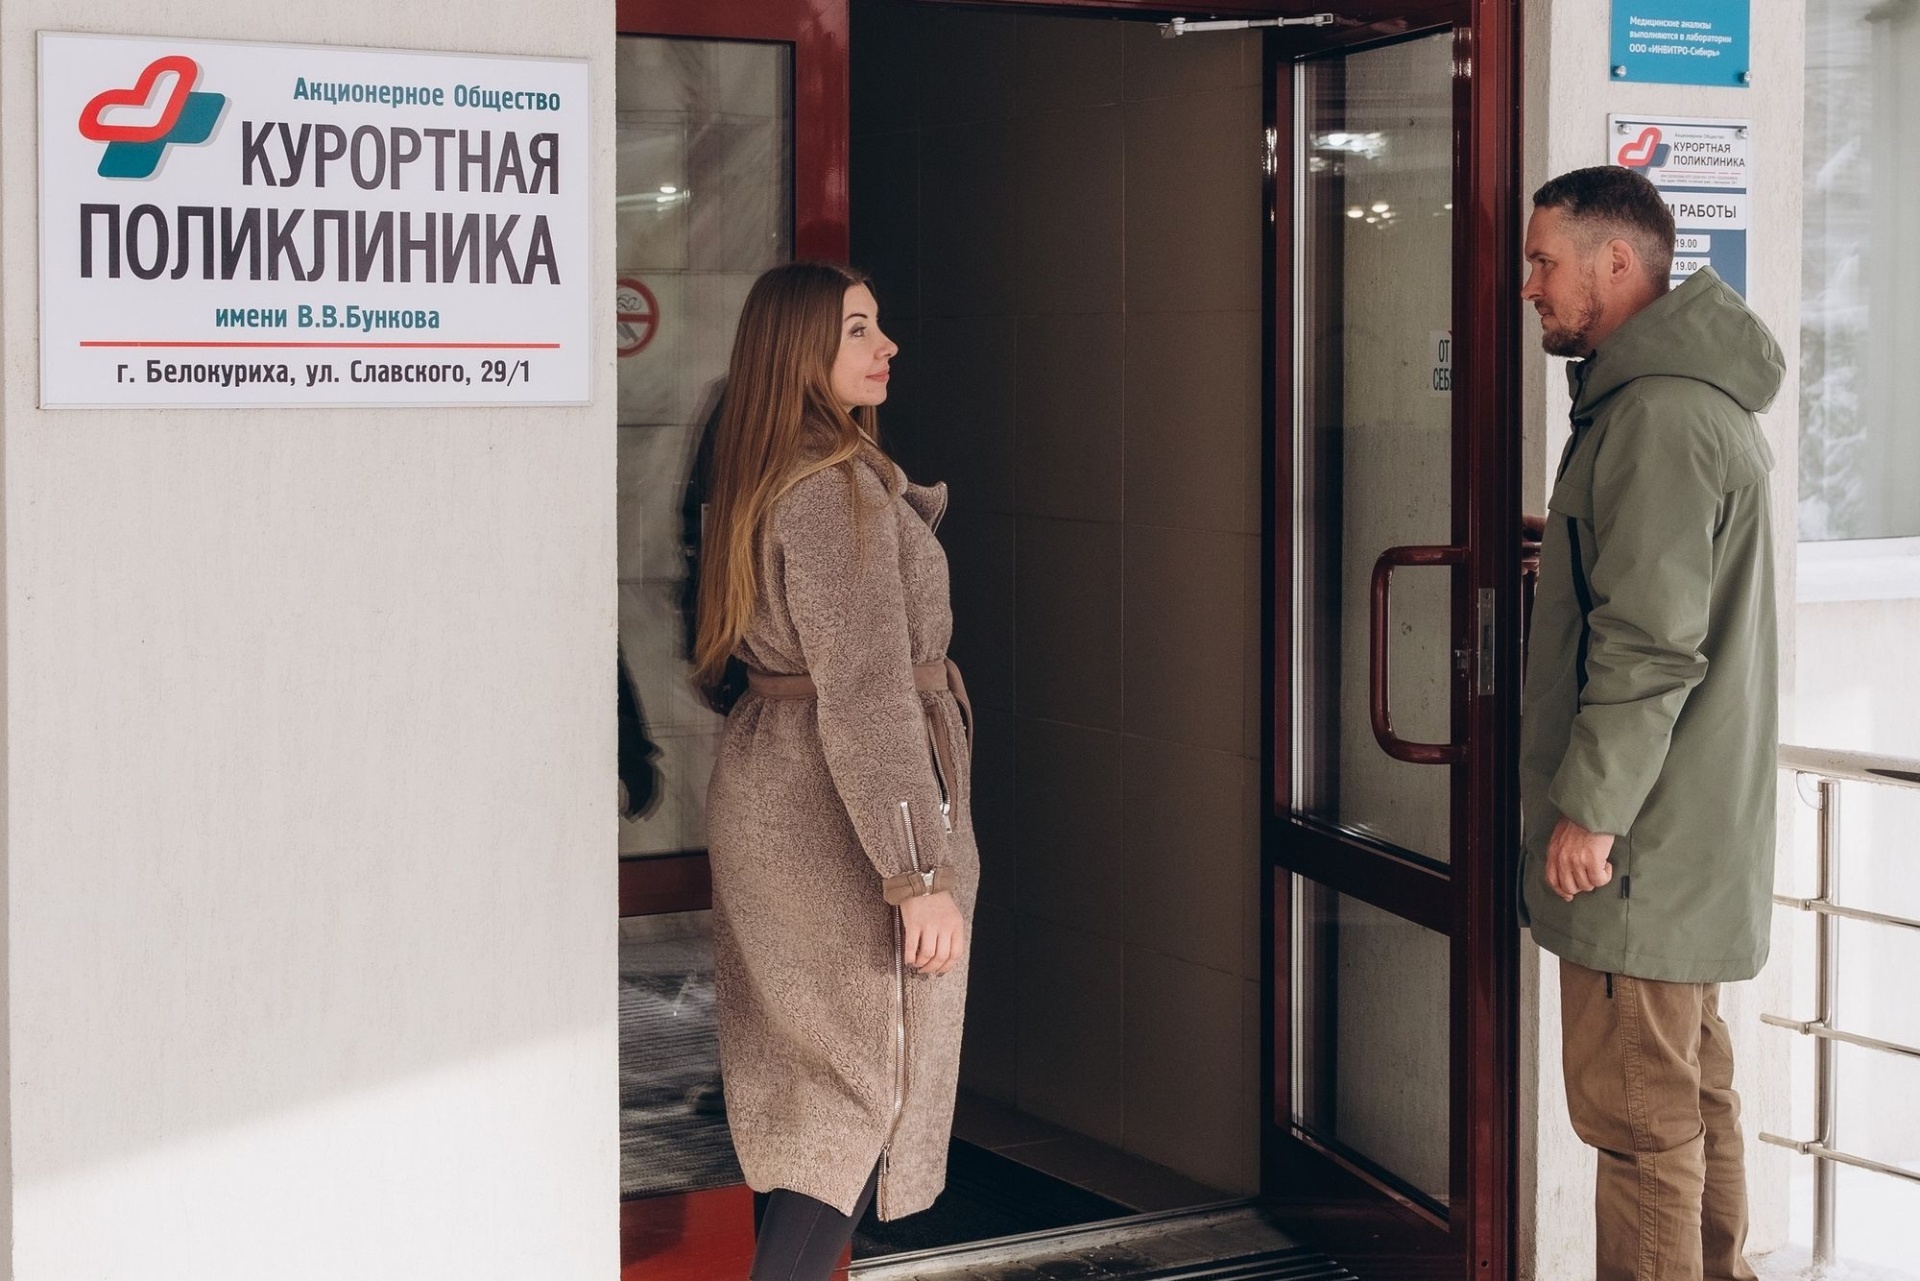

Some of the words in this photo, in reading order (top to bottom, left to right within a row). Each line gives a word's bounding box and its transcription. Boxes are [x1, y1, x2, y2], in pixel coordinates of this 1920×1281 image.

[1629, 16, 1680, 28] Медицинские
[1681, 21, 1712, 30] анализы
[1629, 31, 1679, 41] выполняются
[1686, 33, 1732, 44] лаборатории
[1629, 43, 1647, 53] ООО
[1648, 44, 1720, 58] «ИНВИТРО-Сибирь»
[293, 77, 445, 108] Акционерное
[453, 84, 561, 112] Общество
[1673, 142, 1731, 154] КУРОРТНАЯ
[241, 121, 560, 195] КУРОРТНАЯ
[1673, 155, 1746, 168] ПОЛИКЛИНИКА
[1679, 204, 1737, 218] РАБОТЫ
[78, 203, 561, 285] ПОЛИКЛИНИКА
[1675, 262, 1698, 271] 19.00
[215, 308, 288, 329] имени
[298, 304, 441, 333] В.В.Бункова
[1439, 340, 1450, 362] ОТ
[116, 363, 135, 384] г.
[146, 359, 296, 388] Белокуриха,
[306, 364, 341, 388] ул.
[350, 361, 471, 387] Славского,
[480, 360, 530, 385] 29/1
